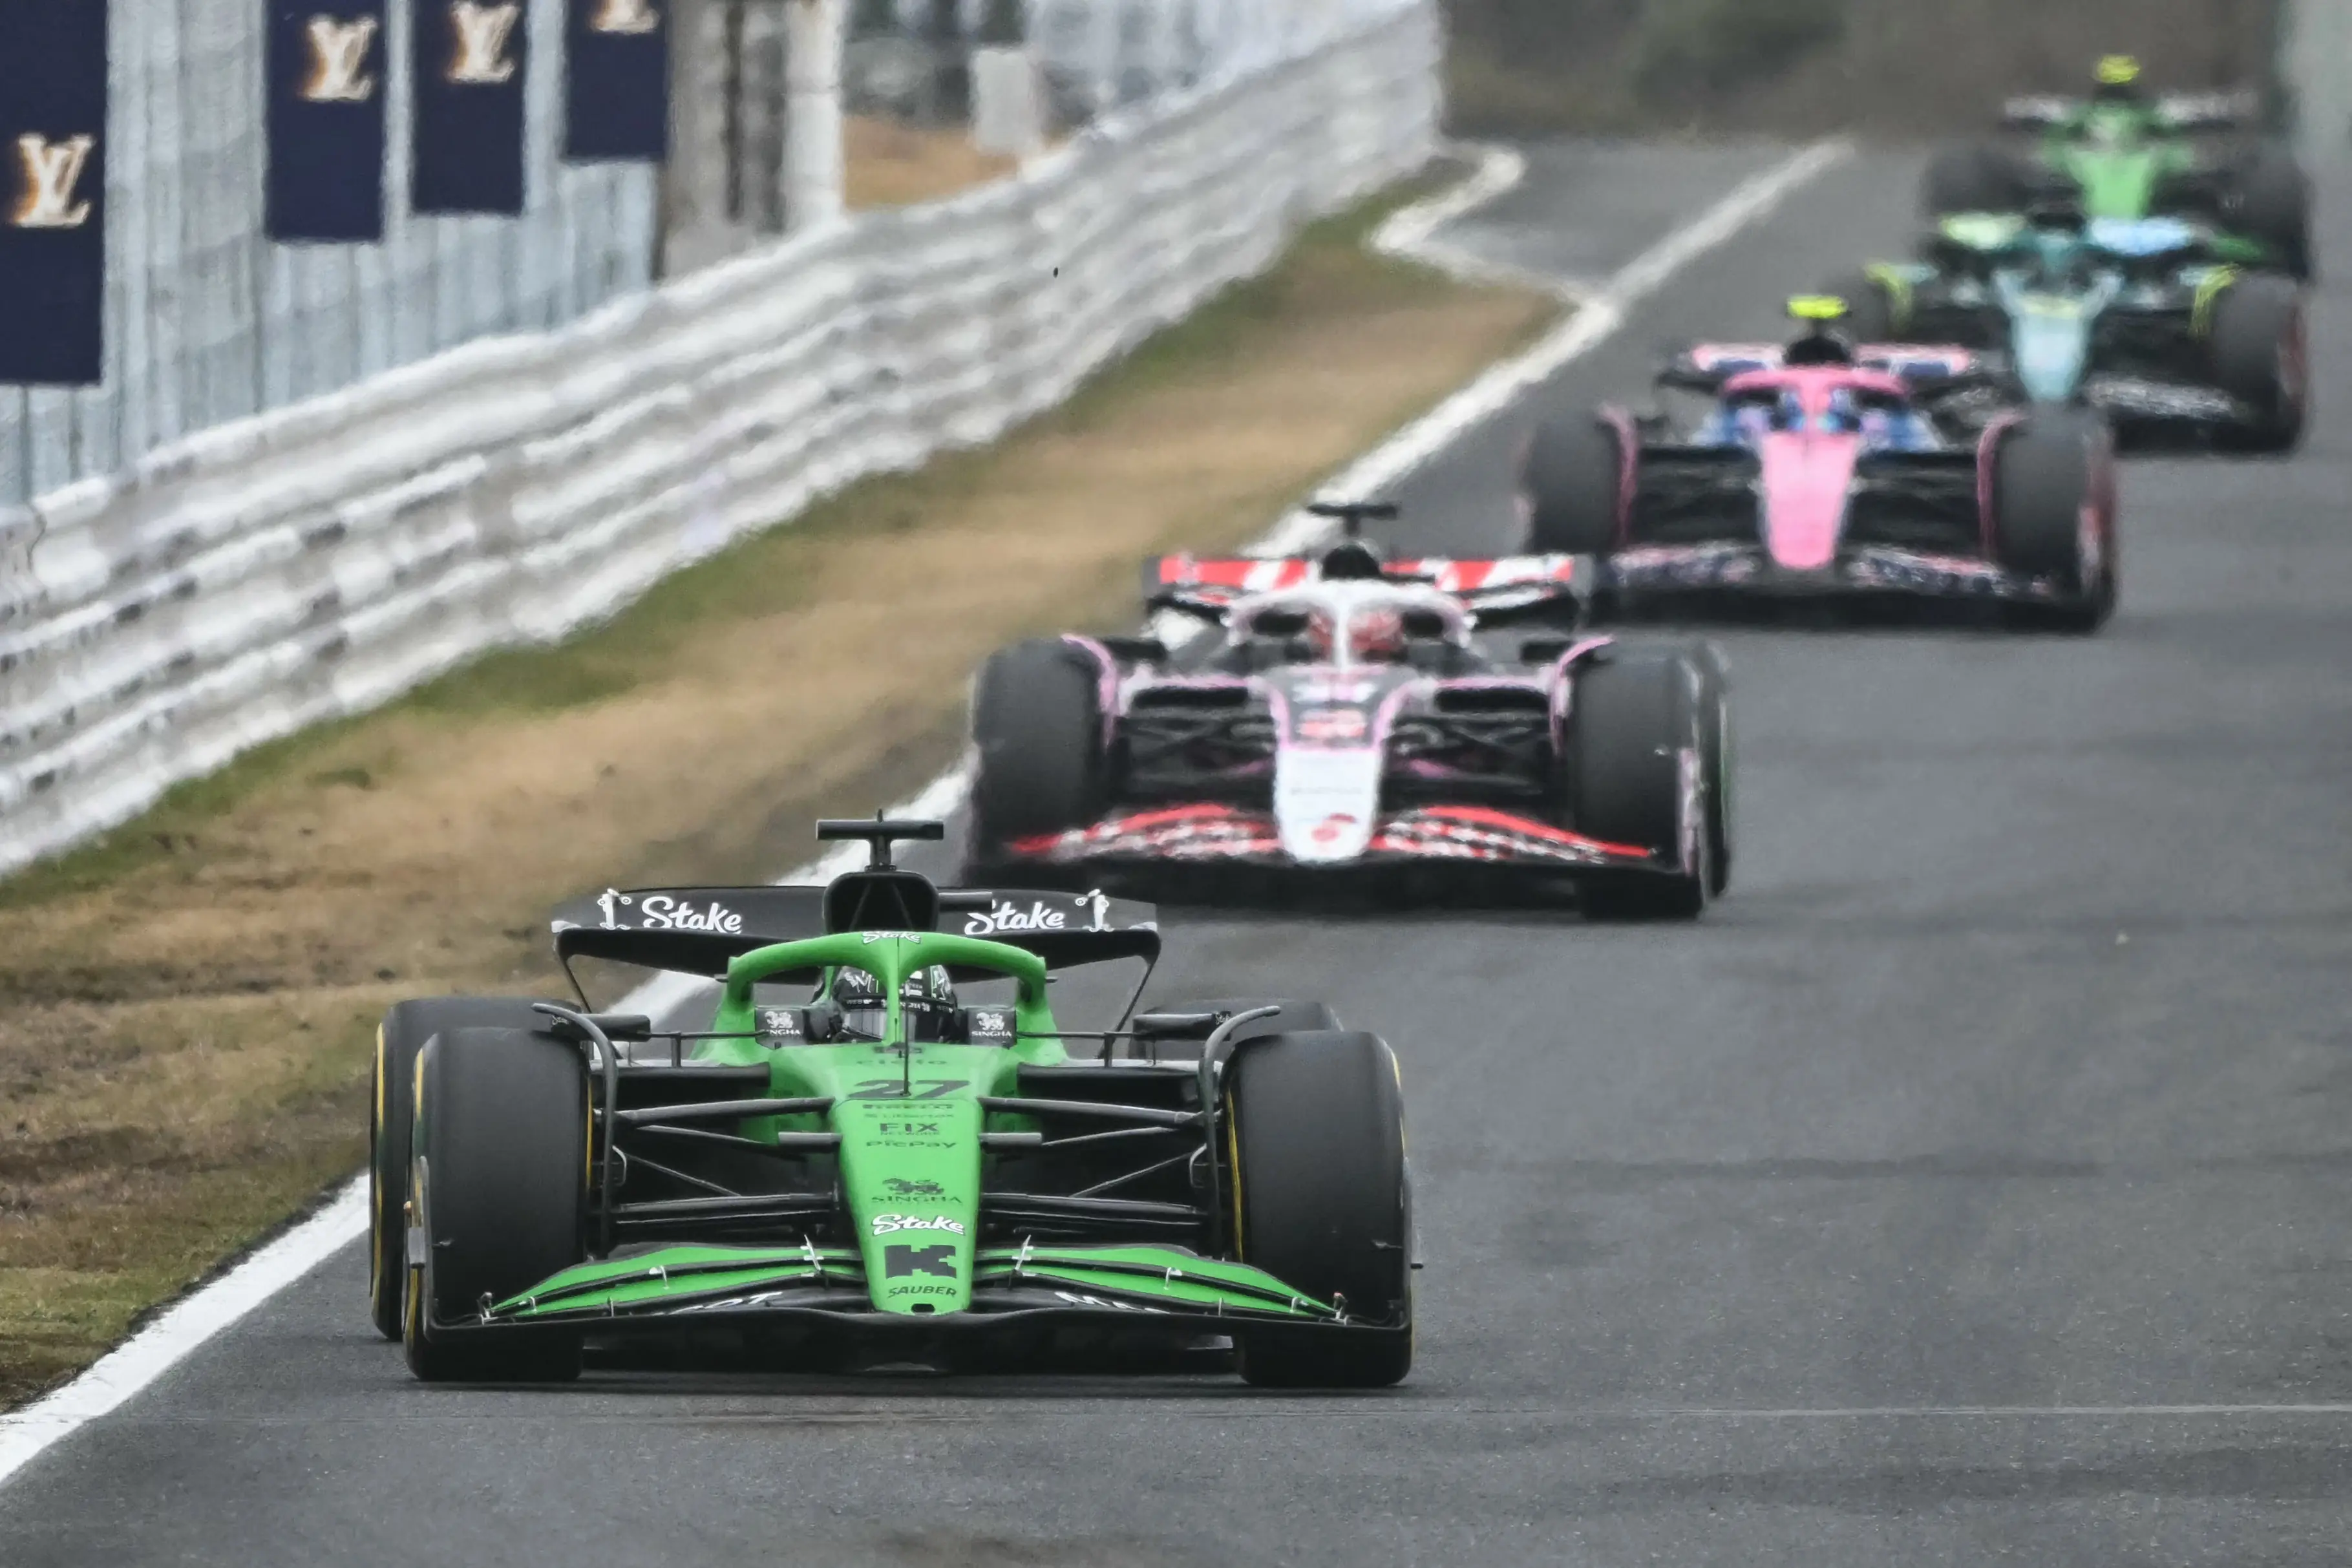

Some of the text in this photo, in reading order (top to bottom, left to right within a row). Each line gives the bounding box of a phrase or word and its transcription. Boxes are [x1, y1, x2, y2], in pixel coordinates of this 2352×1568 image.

[642, 896, 742, 935] Stake
[848, 1079, 971, 1099] 27
[880, 1123, 939, 1132] FIX
[866, 1139, 957, 1149] PicPay
[871, 1196, 963, 1205] SINGHA
[871, 1214, 966, 1236] Stake
[887, 1286, 957, 1298] SAUBER
